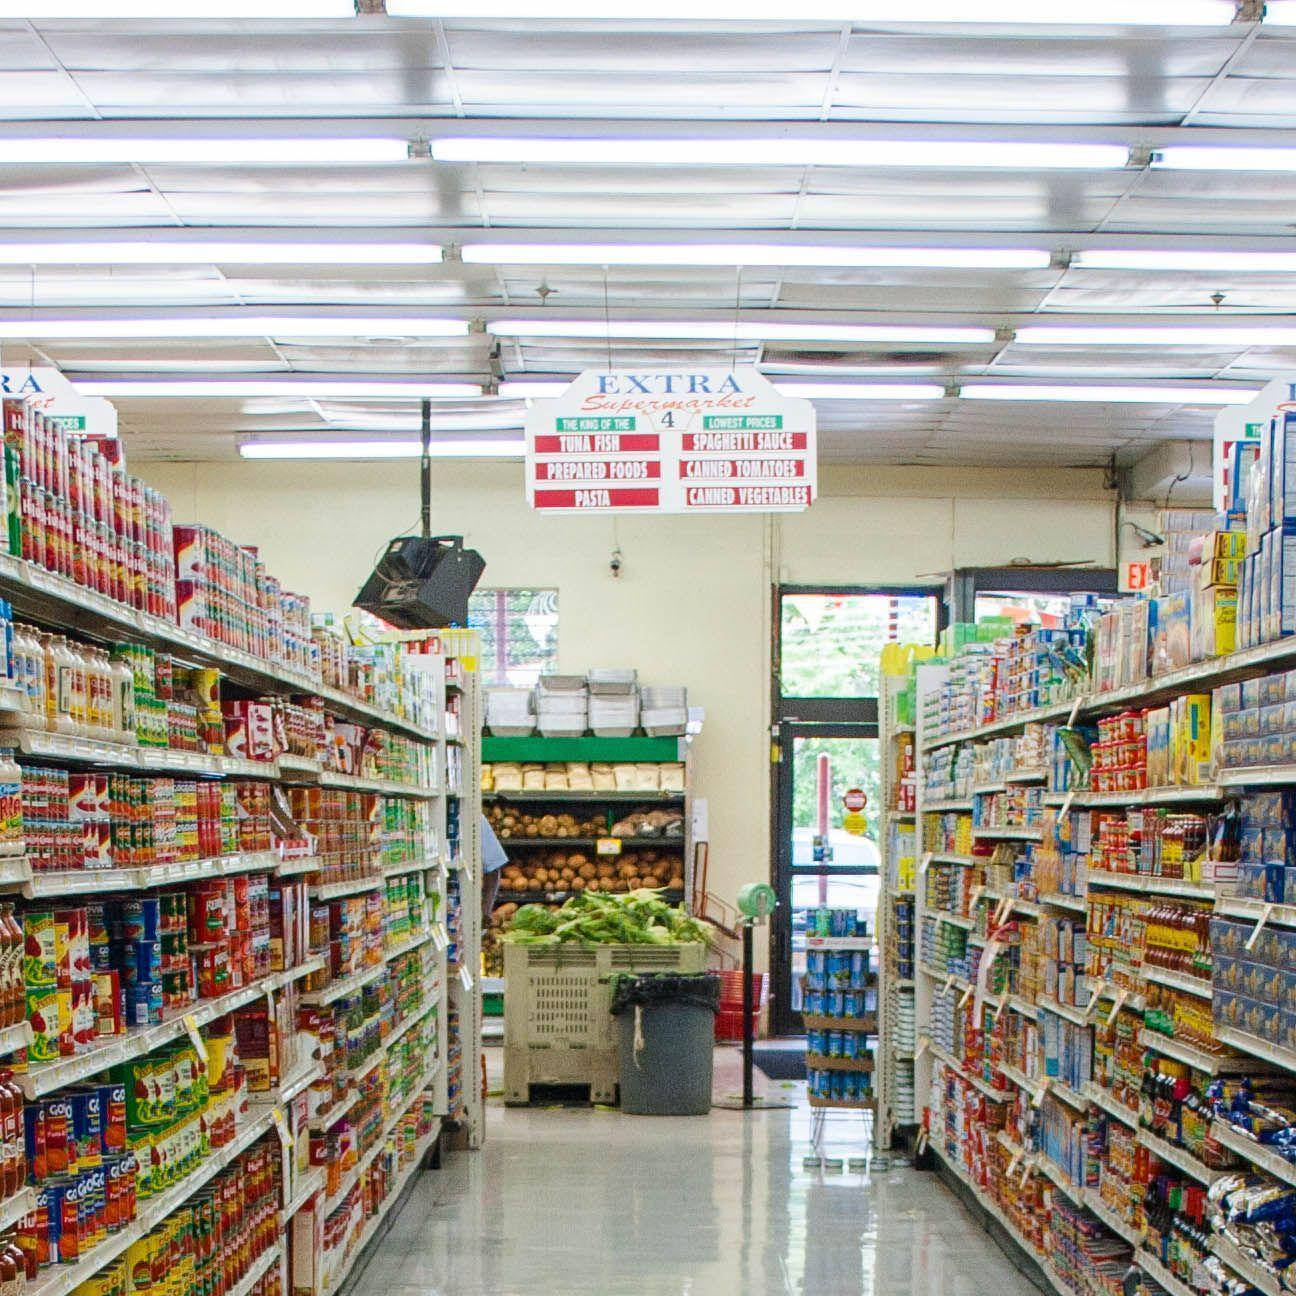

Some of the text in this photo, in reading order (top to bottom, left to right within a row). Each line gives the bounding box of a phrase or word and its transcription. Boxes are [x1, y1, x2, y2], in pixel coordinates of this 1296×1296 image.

[599, 373, 744, 394] EXTRA
[581, 393, 755, 413] Supermarket
[661, 411, 675, 428] 4
[709, 416, 776, 428] LOWEST PRICES
[560, 435, 619, 452] TUNA FISH
[693, 433, 793, 450] SPAGHETTI SAUCE
[547, 462, 648, 479] PREPARED FOODS
[686, 460, 796, 478] CANNED TOMATOES
[575, 490, 611, 507] PASTA
[690, 486, 808, 506] CANNED VEGETABLES
[1128, 563, 1147, 589] EX
